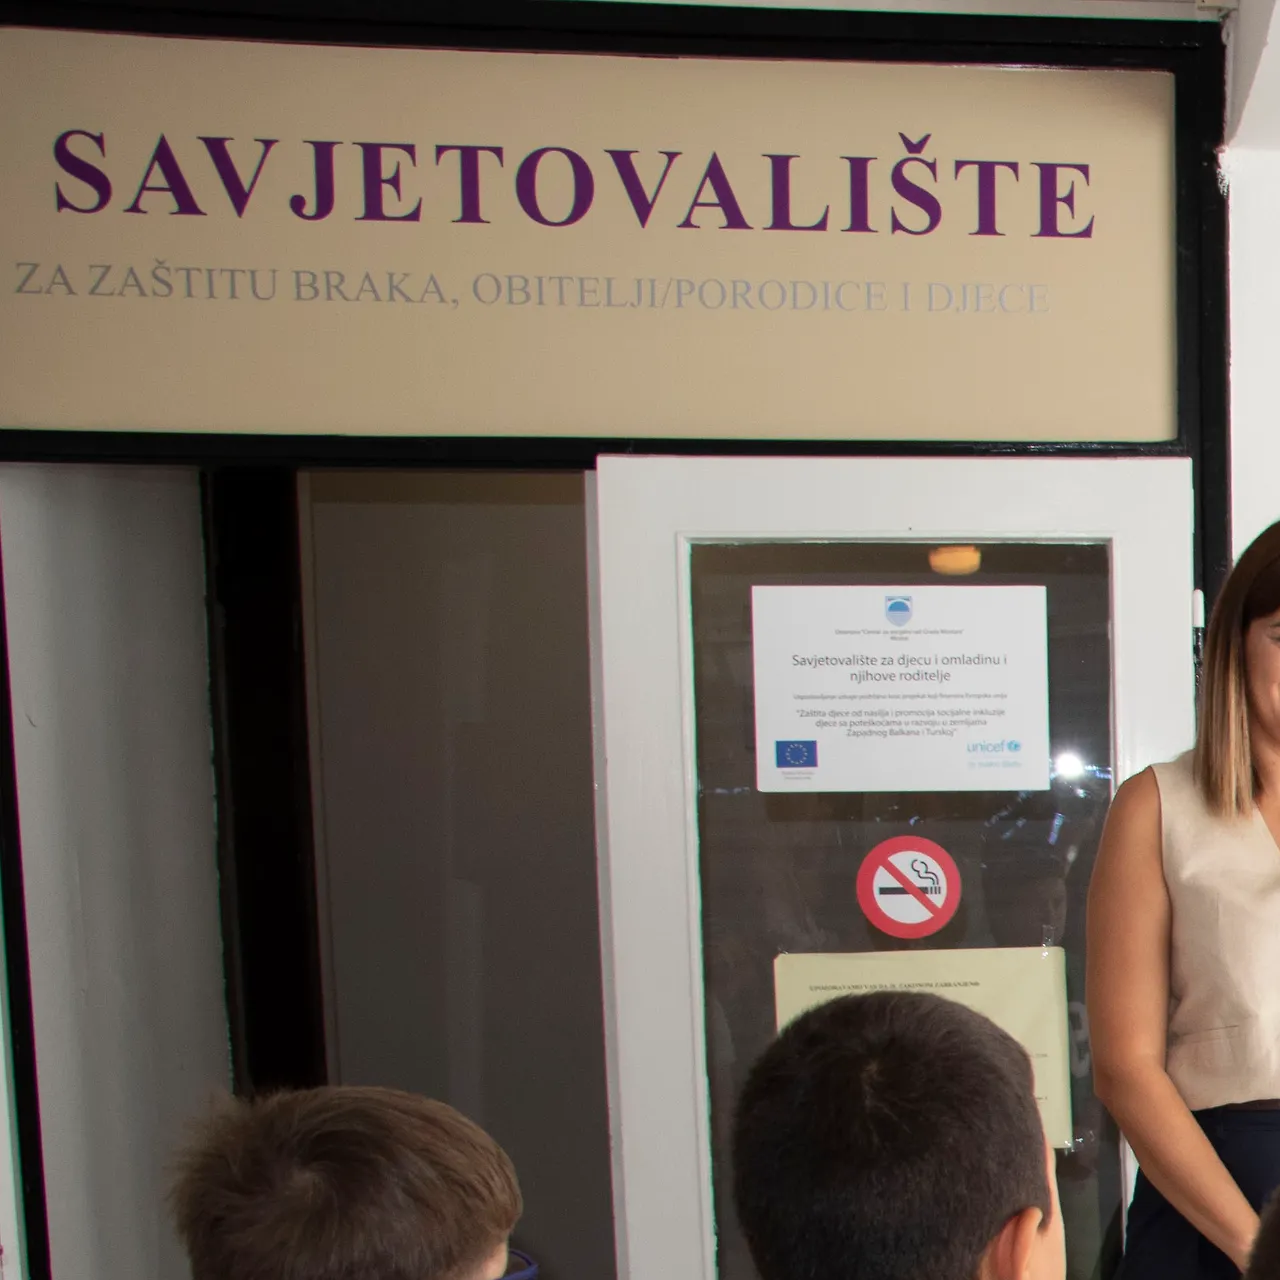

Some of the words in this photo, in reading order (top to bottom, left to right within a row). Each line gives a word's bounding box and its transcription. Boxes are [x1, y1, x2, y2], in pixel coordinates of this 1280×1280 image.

[53, 130, 1094, 238] SAVJETOVALIŠTE
[15, 262, 77, 296] ZA
[88, 258, 279, 300] ZAŠTITU
[293, 268, 459, 309] BRAKA,
[472, 272, 885, 311] OBITELJI/PORODICE
[900, 281, 911, 312] I
[926, 282, 1051, 315] DJECE
[792, 654, 877, 668] Savjetovalište
[881, 657, 894, 665] za
[897, 654, 931, 668] djecu
[934, 654, 938, 665] i
[941, 653, 1000, 665] omladinu
[1004, 654, 1008, 664] i
[850, 670, 896, 684] njihove
[899, 669, 951, 683] roditelje
[967, 739, 1005, 752] unicef
